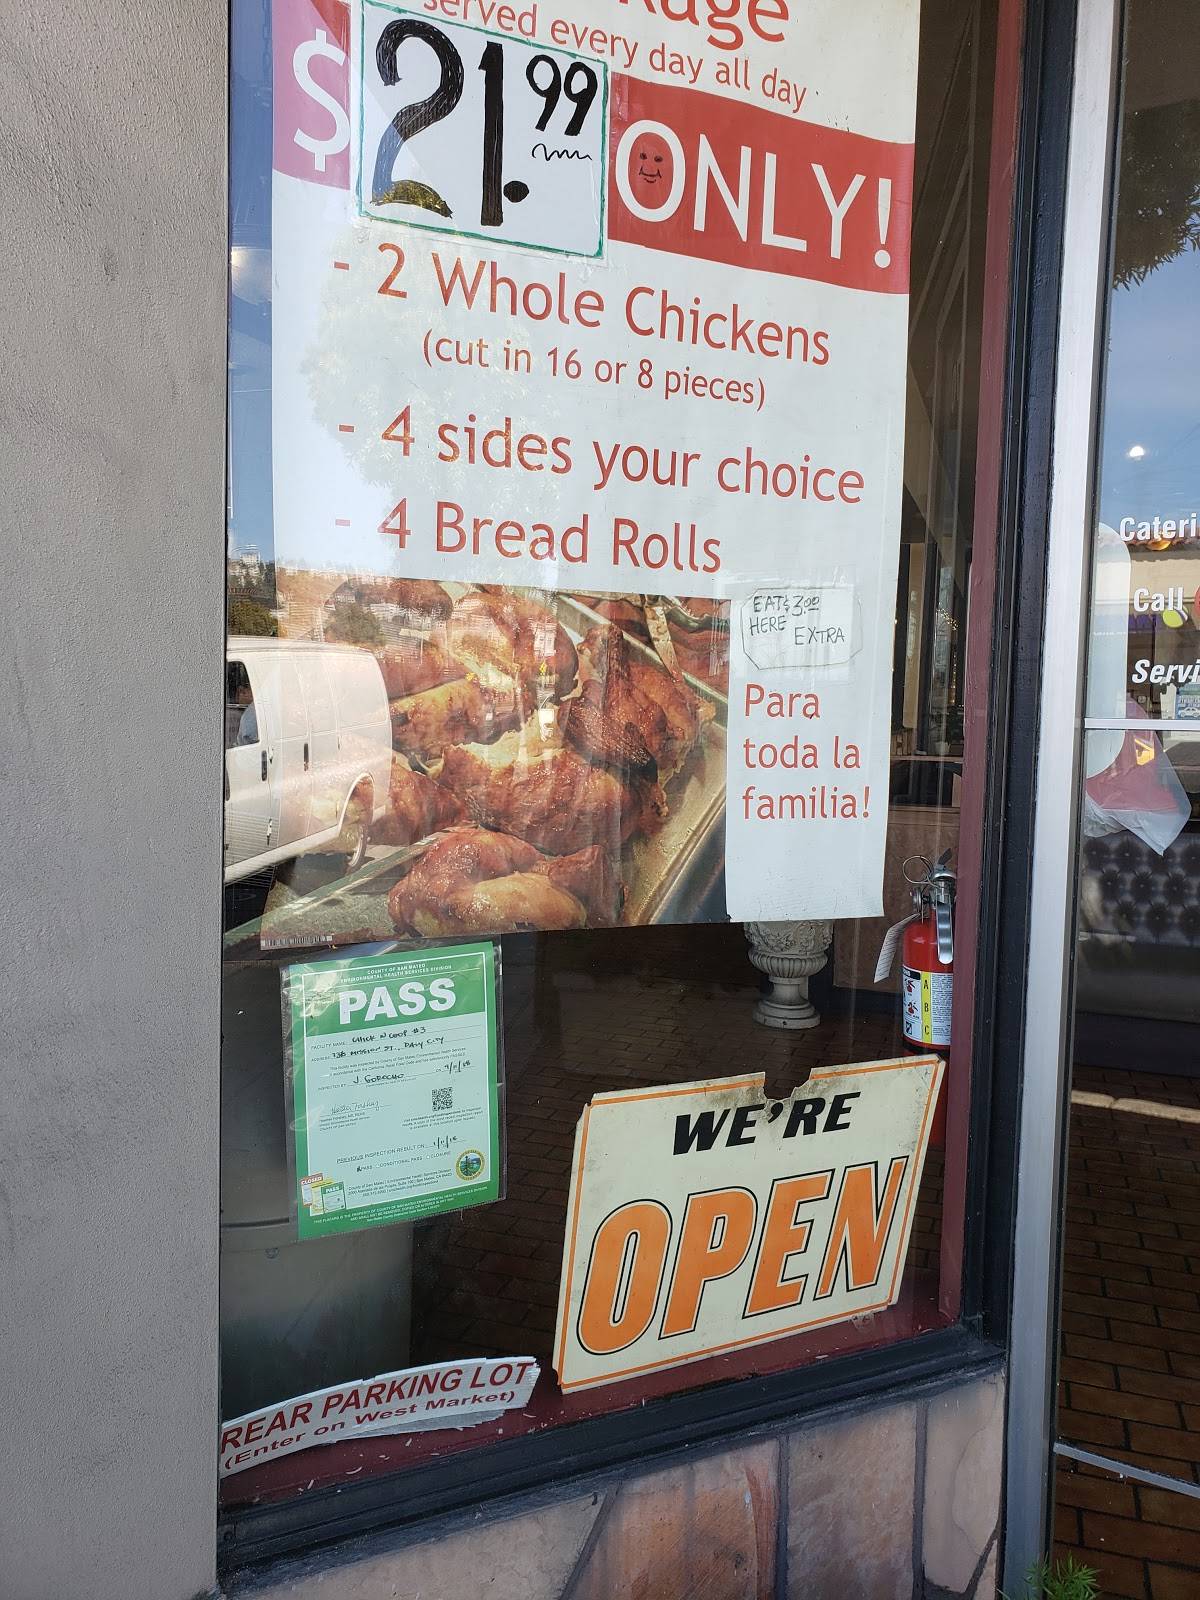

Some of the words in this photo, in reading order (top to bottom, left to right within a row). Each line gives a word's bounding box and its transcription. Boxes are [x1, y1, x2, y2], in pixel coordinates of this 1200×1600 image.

[550, 19, 639, 68] every
[649, 43, 703, 83] day
[716, 55, 750, 90] all
[761, 67, 806, 113] day
[615, 119, 892, 269] ONLY!
[377, 243, 407, 299] 2
[431, 252, 605, 328] Whole
[625, 286, 830, 366] Chickens
[423, 329, 489, 367] (cut
[504, 340, 532, 374] in
[547, 347, 582, 380] 16
[595, 358, 628, 385] or
[637, 360, 653, 389] 8
[665, 368, 766, 410] pieces)
[381, 405, 415, 457] 4
[437, 413, 572, 475] sides
[593, 441, 701, 491] your
[717, 447, 865, 504] choice
[377, 497, 411, 549] 4
[436, 501, 590, 564] Bread
[612, 517, 721, 573] Rolls
[1120, 513, 1196, 541] Cateri
[754, 595, 784, 613] EAT
[1134, 587, 1183, 612] Call
[750, 615, 787, 636] HERE
[794, 626, 845, 646] EXTRA
[745, 683, 820, 719] Para
[743, 736, 819, 769] toda
[833, 736, 860, 769] la
[742, 785, 870, 820] familia!
[340, 978, 456, 1024] PASS
[924, 980, 928, 989] A
[924, 1003, 929, 1012] B
[924, 1025, 929, 1035] C
[673, 1091, 861, 1155] WE'RE
[576, 1155, 909, 1355] OPEN
[221, 1402, 313, 1454] REAR
[322, 1368, 463, 1418] PARKING
[469, 1362, 534, 1389] LOT
[225, 1432, 306, 1470] (Enter
[313, 1420, 345, 1436] on
[355, 1403, 418, 1424] West
[425, 1391, 515, 1411] Market)
